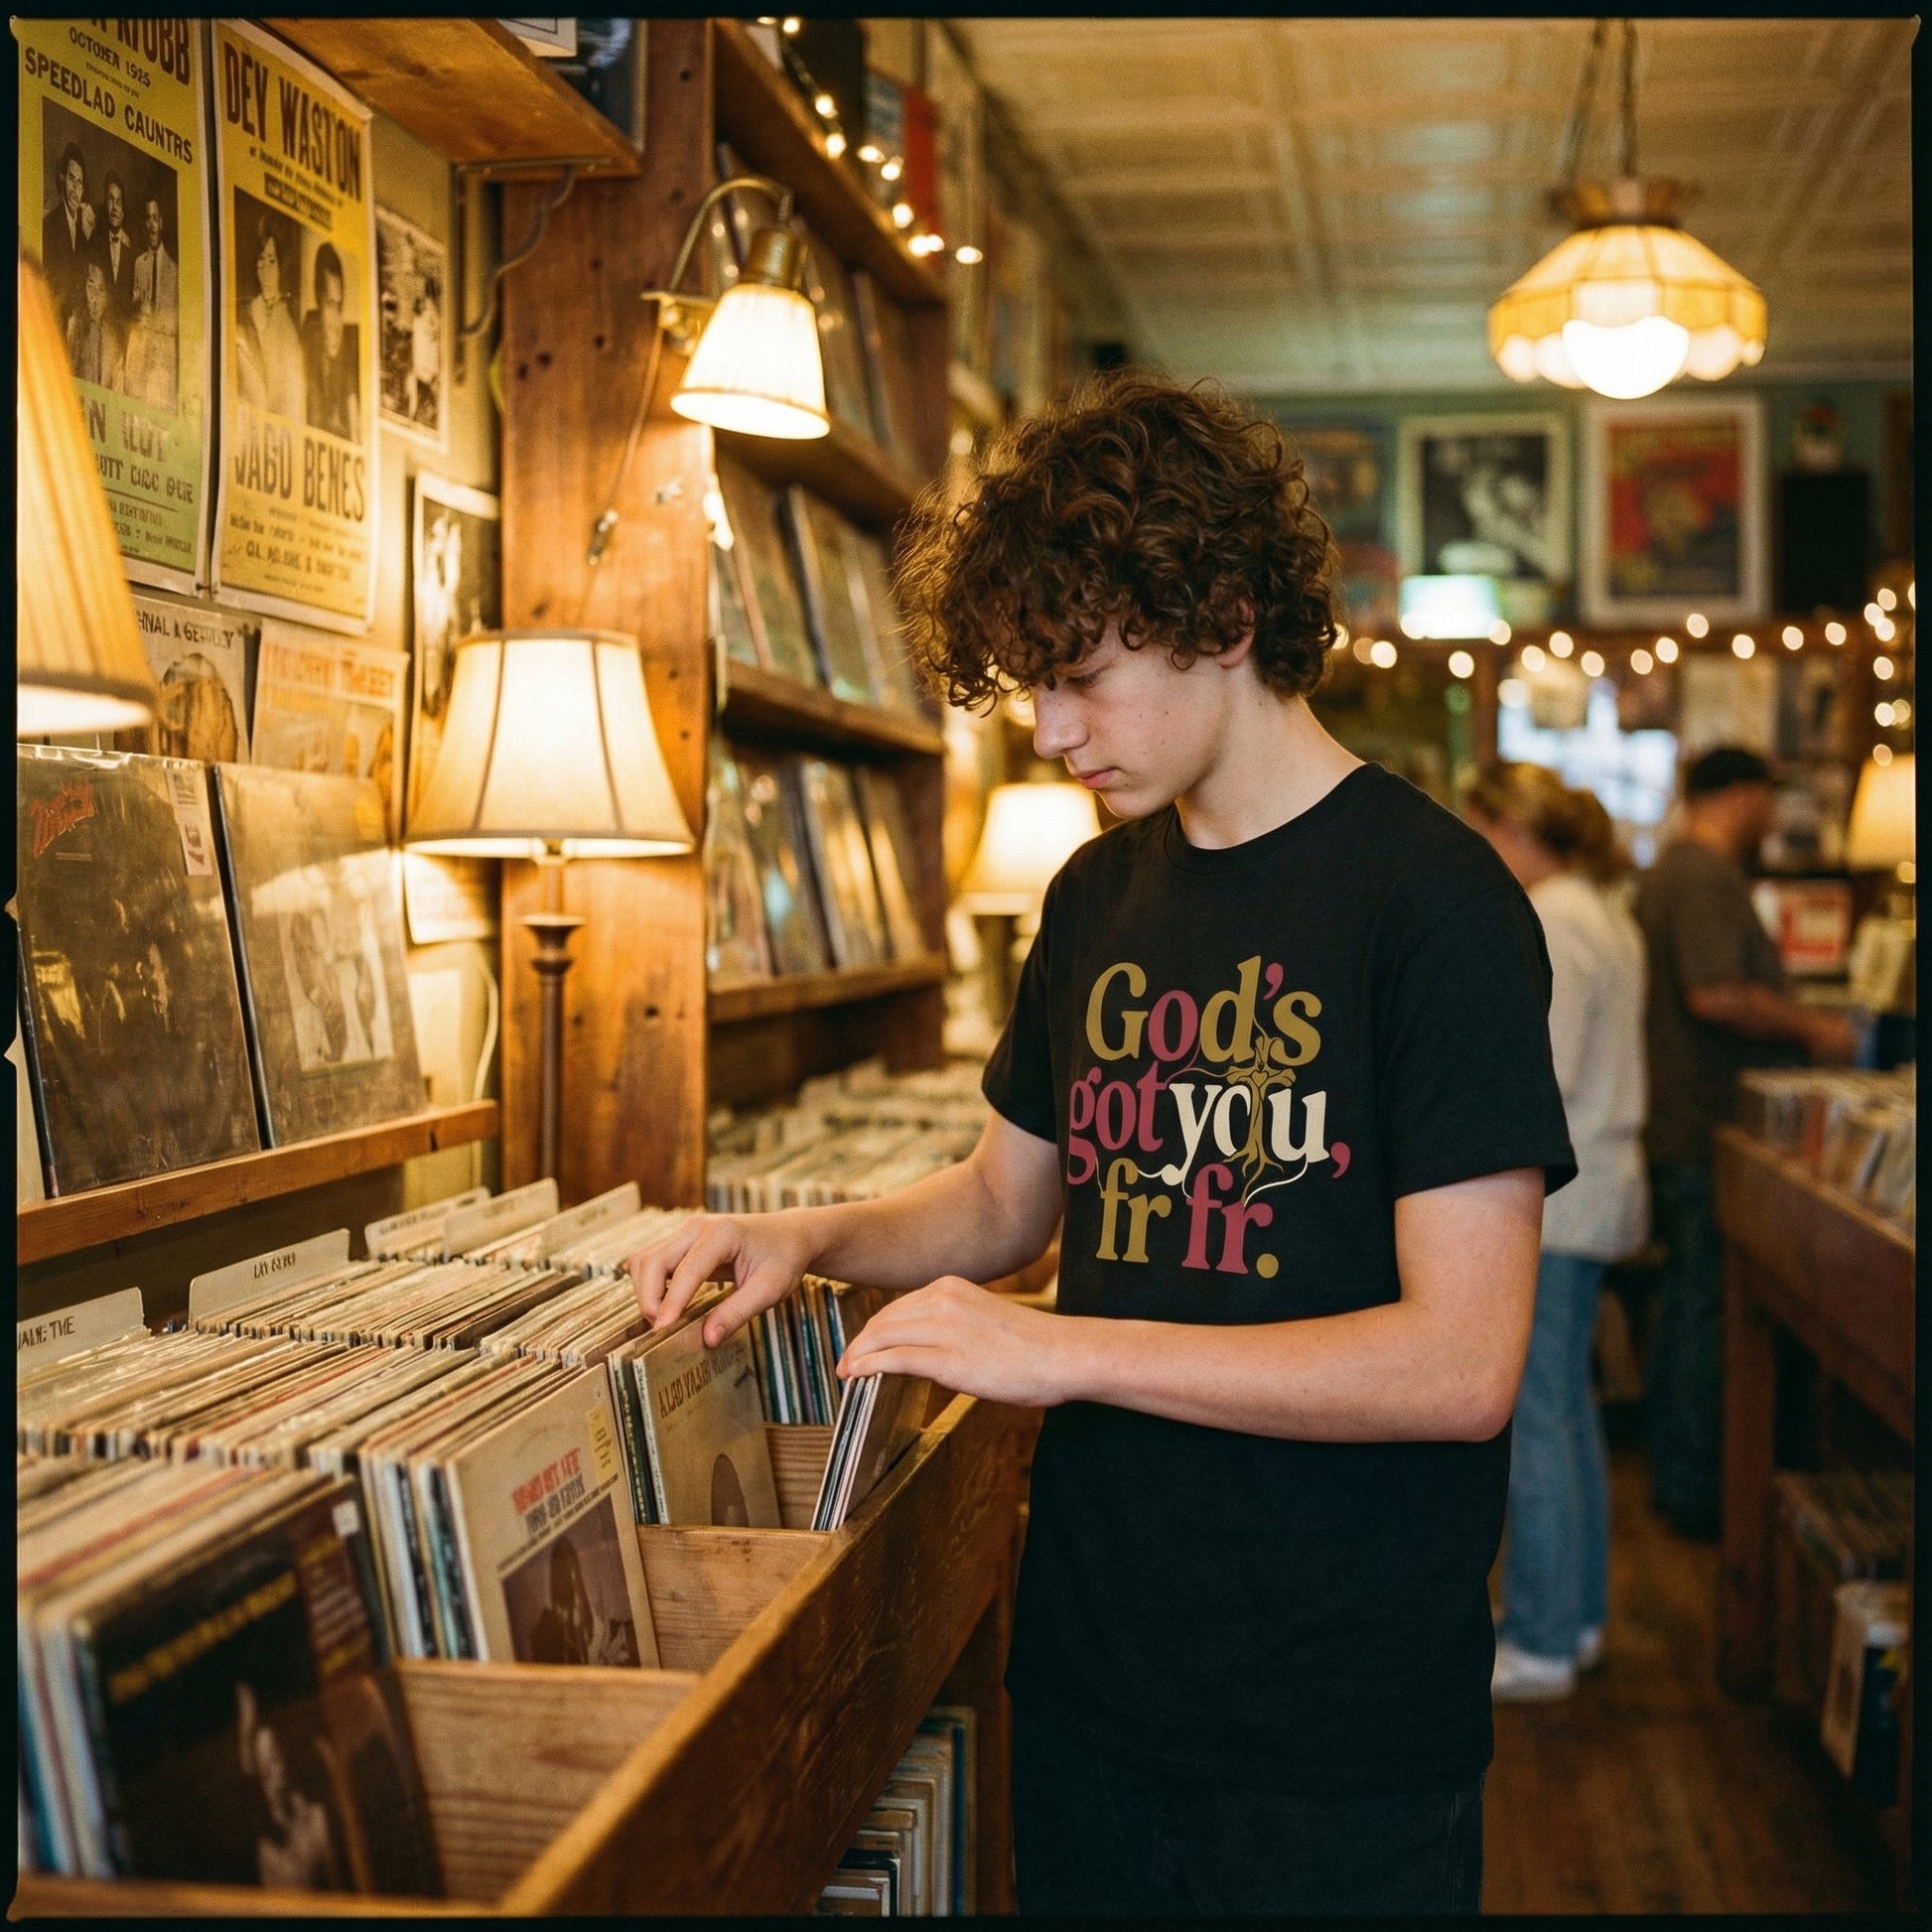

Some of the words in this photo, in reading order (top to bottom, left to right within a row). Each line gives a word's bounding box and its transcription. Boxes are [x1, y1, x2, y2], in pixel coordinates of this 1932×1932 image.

[25, 47, 115, 119] SPEEDLAD
[124, 104, 193, 165] CAUNTRS
[223, 41, 269, 143] DEY
[1086, 955, 1322, 1066] God's
[1066, 1061, 1169, 1185] got
[1162, 1083, 1351, 1186] you,
[1096, 1157, 1173, 1264] fr
[1181, 1163, 1280, 1279] fr.
